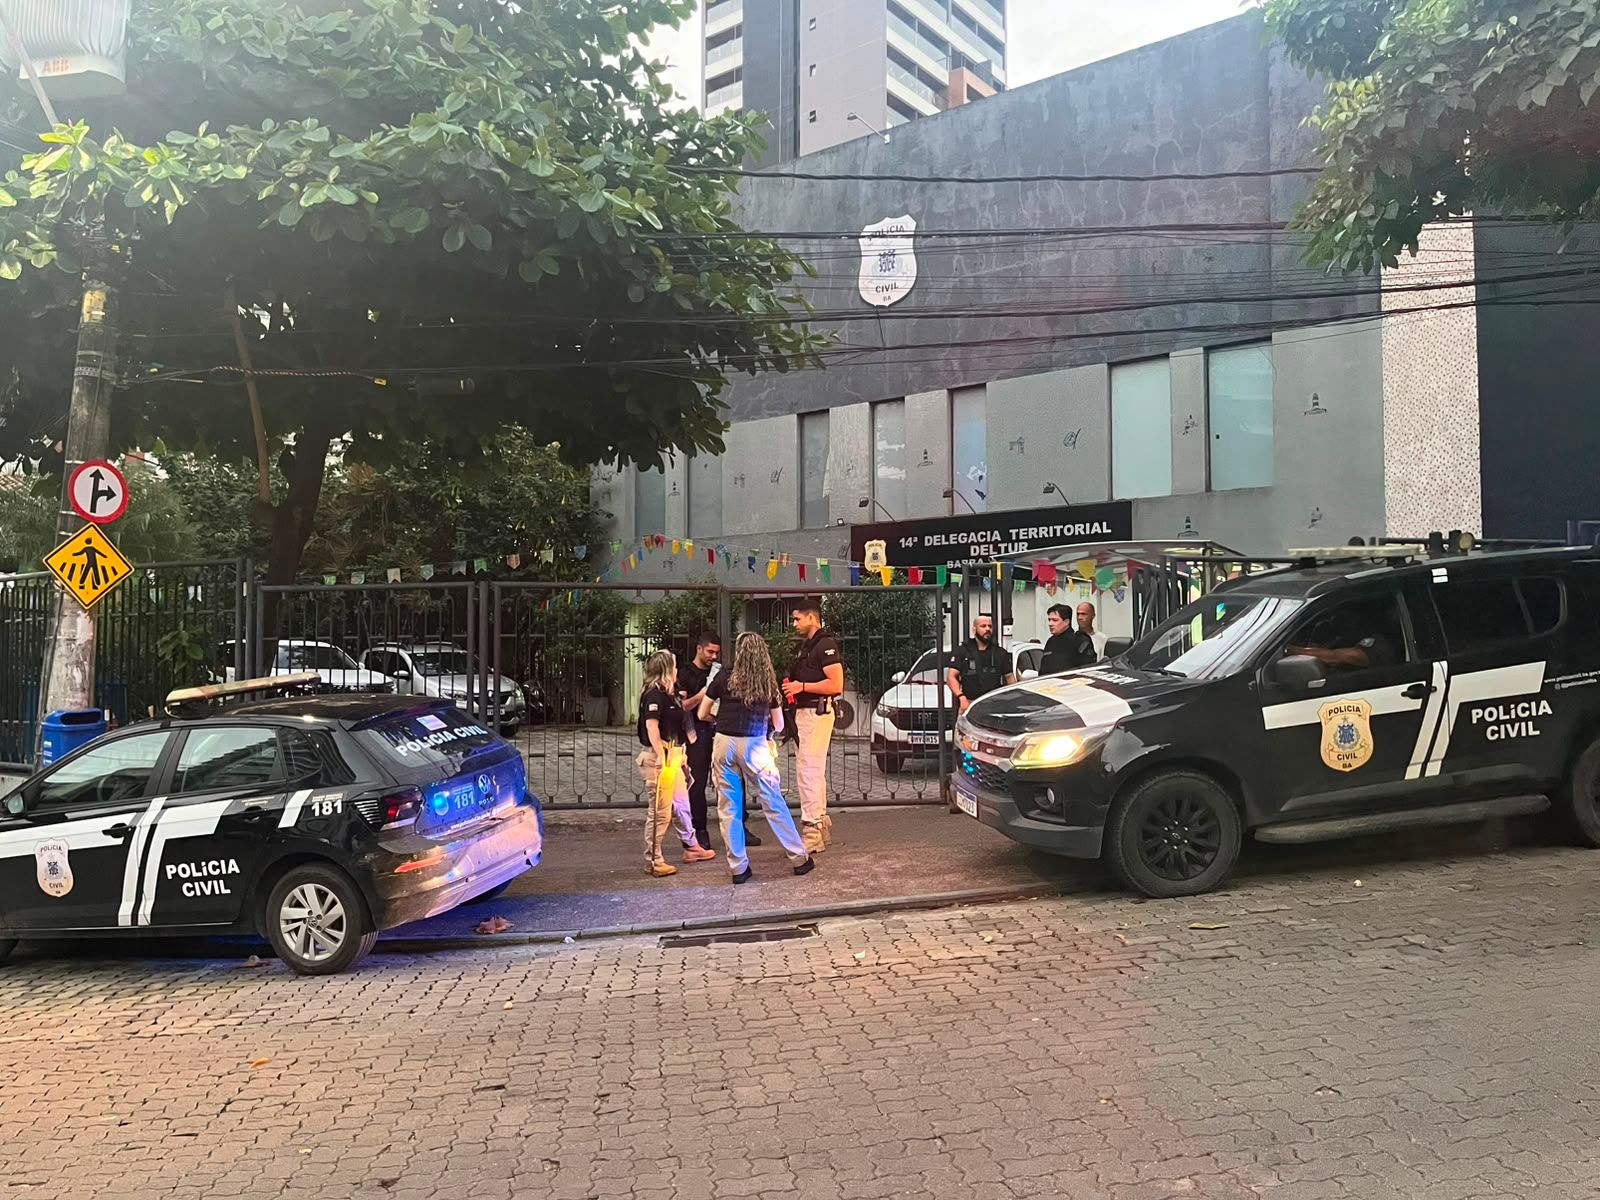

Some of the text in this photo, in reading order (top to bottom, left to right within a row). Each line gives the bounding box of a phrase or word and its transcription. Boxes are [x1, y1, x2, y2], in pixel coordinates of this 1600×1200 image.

[42, 58, 69, 73] ABB
[875, 282, 899, 293] CIVIL
[899, 521, 1112, 548] 14ª DELEGACIA TERRITORIAL
[970, 541, 1028, 556] DELTUR
[453, 724, 488, 738] CIVIL
[1486, 721, 1540, 741] CIVIL
[1337, 752, 1358, 761] CIVIL
[311, 799, 342, 817] 181
[454, 791, 474, 809] 181
[182, 879, 231, 897] CIVIL
